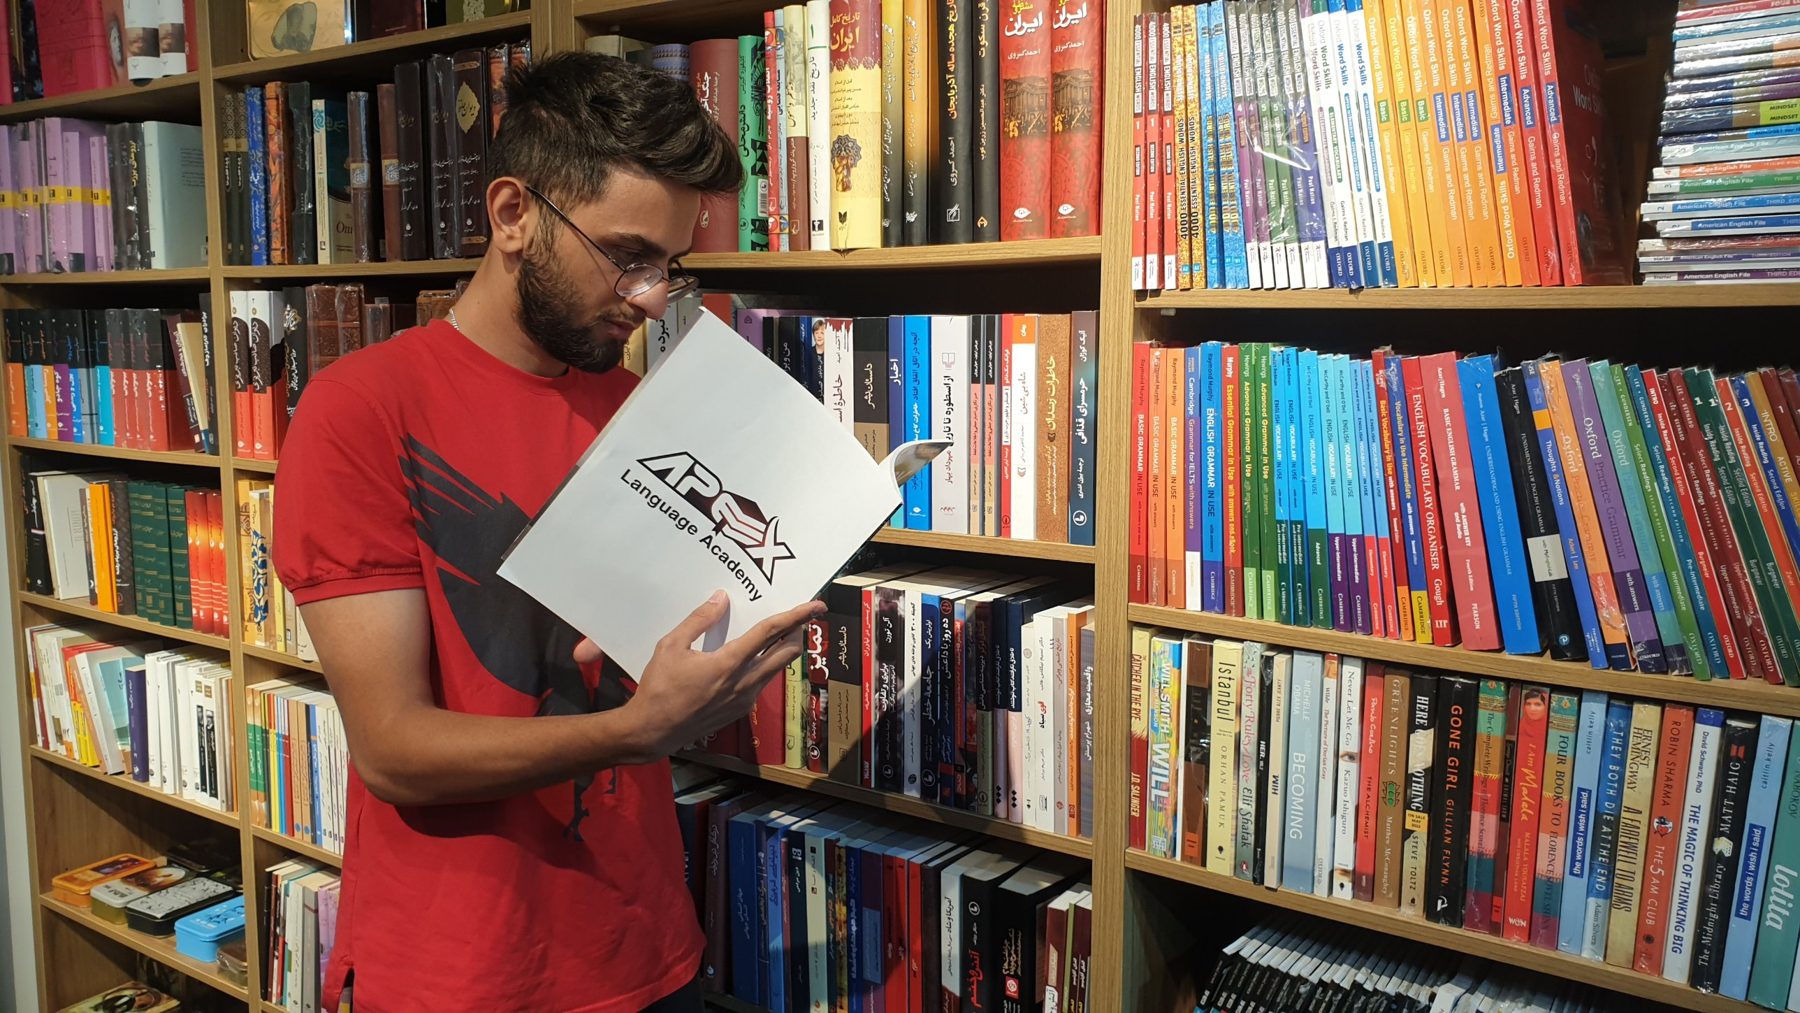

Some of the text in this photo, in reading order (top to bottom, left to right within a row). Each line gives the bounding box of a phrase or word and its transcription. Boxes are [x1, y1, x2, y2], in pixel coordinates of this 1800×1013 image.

[831, 26, 860, 51] ایران
[1005, 11, 1043, 37] ایران
[1053, 2, 1087, 29] ایران
[1368, 17, 1388, 122] Oxford Word Skills Basic
[1511, 0, 1543, 209] Oxford Word Skills Advanced Gairns and Redman
[1364, 246, 1372, 271] OXFORD
[889, 358, 902, 386] اخبار
[1188, 377, 1196, 415] Cambridge
[1226, 357, 1234, 378] Murphy
[1226, 384, 1235, 418] Essential
[1206, 408, 1215, 517] ENGLISH GRAMMAR IN USE
[1226, 419, 1235, 456] Grammar
[1171, 476, 1177, 484] IN
[1227, 467, 1235, 480] Use
[1412, 394, 1444, 606] ENGLISH VOCABULARY ORGANISER Gough
[619, 468, 763, 603] Language Academy
[1582, 417, 1640, 611] Oxford Practice Grammar with answers
[1471, 603, 1480, 630] PEARSON
[807, 625, 829, 680] تمایز
[1131, 654, 1142, 721] CATCHER IN THE RYE
[1160, 663, 1171, 733] WILL SMITH
[1216, 662, 1236, 722] Istanbul
[1292, 685, 1301, 715] OBAMA
[1302, 680, 1312, 721] MICHELLE
[1344, 671, 1354, 746] Never Let Me Go
[1387, 679, 1400, 776] GREENLIGHTS
[1446, 705, 1463, 791] GONE GIRL
[1640, 728, 1653, 768] ERNEST
[1151, 743, 1170, 802] WILL
[1218, 745, 1228, 829] ORHAN PAMUK
[1271, 775, 1280, 795] HIM
[1527, 750, 1536, 767] Am
[1627, 726, 1644, 792] HEMINGWAY
[1660, 720, 1682, 807] ROBIN SHARMA
[1130, 772, 1140, 817] J.D. SALINGER
[1239, 787, 1256, 848] Elif Shafak
[1289, 752, 1306, 840] BECOMING
[1340, 769, 1350, 835] Kazuo Ishiguro
[1363, 794, 1372, 839] ALCHEMIST
[1519, 768, 1537, 822] Malala
[1595, 731, 1624, 892] THEY BOTH DIE AT THE END
[1720, 761, 1743, 834] MATT HAIG
[1409, 835, 1418, 890] STEVE TOLTZ
[1440, 799, 1455, 884] GILLIAN FLYNN
[1612, 806, 1643, 912] A FAREWELL TO ARMS
[1645, 845, 1665, 926] THE 5 AM CLUB
[1671, 804, 1702, 954] THE MAGIC OF THINKING BIG
[1764, 864, 1798, 931] lolita
[1698, 863, 1726, 967] The Midnight Library
